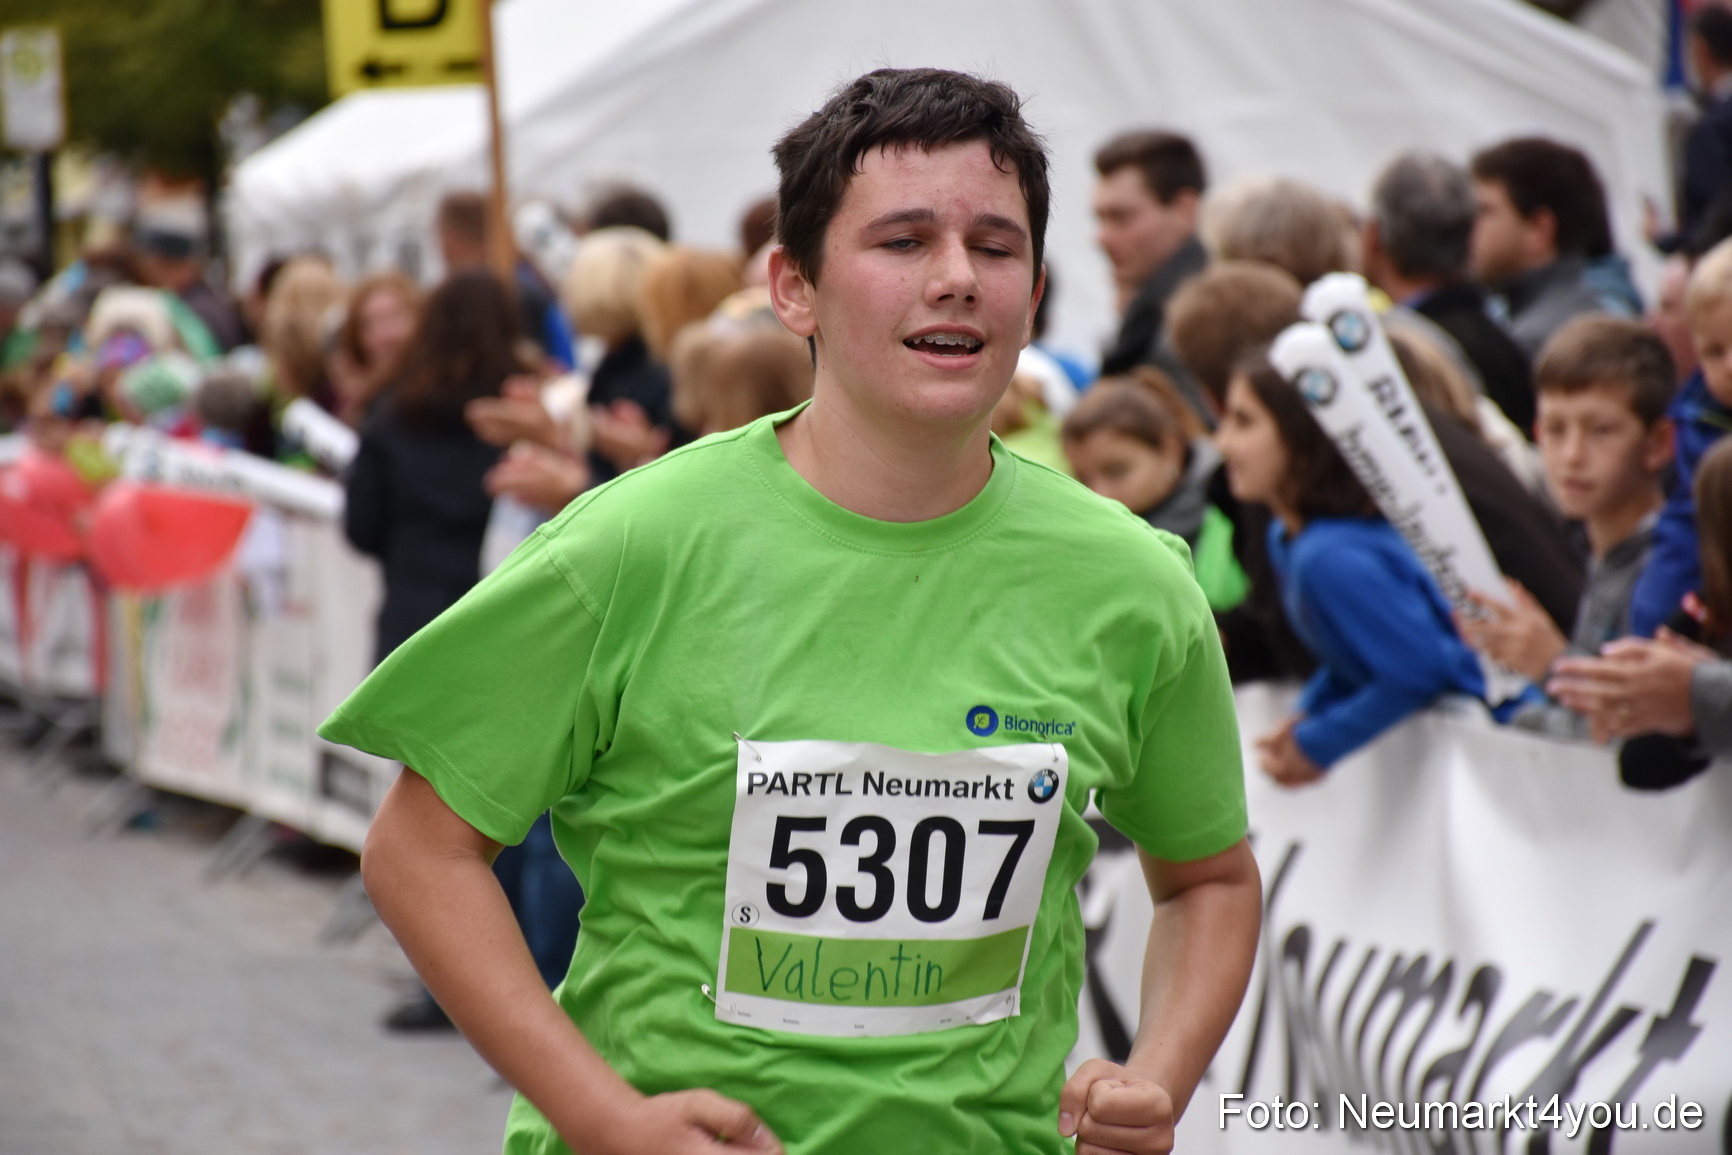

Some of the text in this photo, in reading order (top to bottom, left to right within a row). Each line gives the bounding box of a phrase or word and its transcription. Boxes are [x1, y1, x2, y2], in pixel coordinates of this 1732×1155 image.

[747, 771, 853, 797] PARTL
[862, 771, 1015, 801] Neumarkt
[765, 814, 1036, 923] 5307
[738, 905, 752, 923] S
[755, 936, 943, 1001] Valentin
